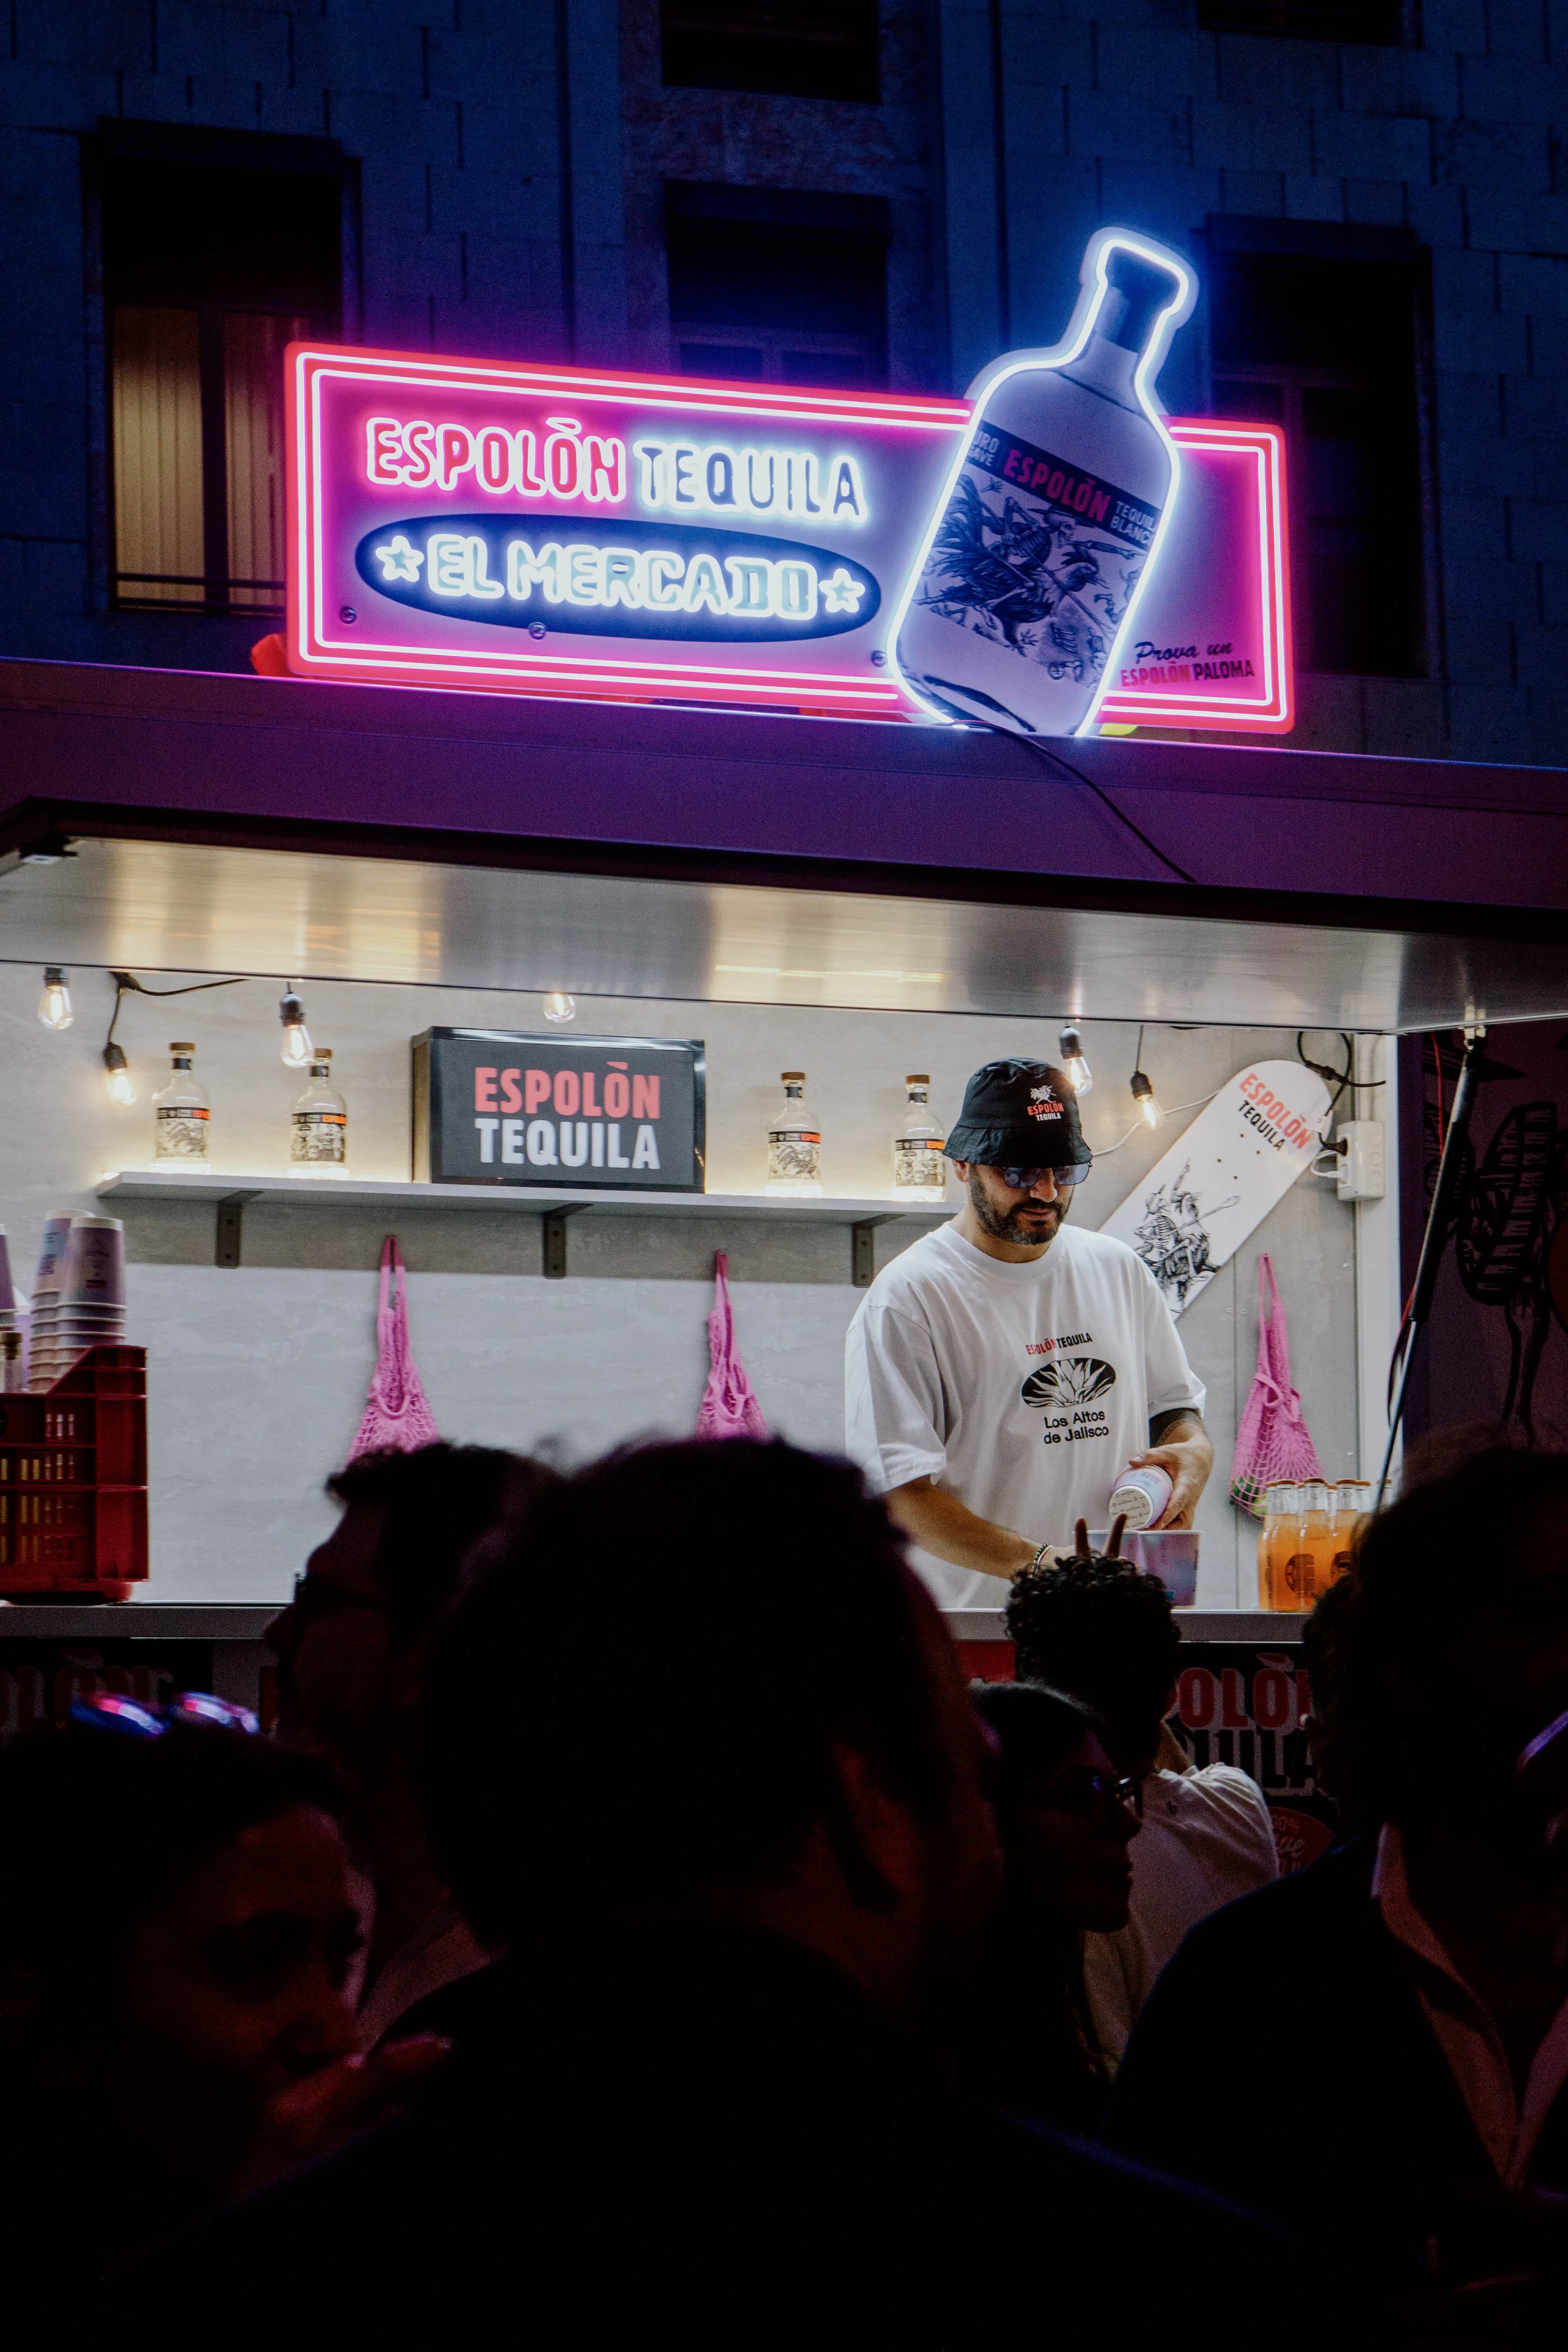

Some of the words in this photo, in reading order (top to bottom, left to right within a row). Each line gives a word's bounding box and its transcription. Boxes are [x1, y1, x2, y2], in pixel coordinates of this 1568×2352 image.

[633, 440, 867, 523] TEQUILA
[427, 534, 505, 599] EL
[507, 540, 817, 621] MERCADO
[1134, 641, 1200, 664] Prova
[1207, 642, 1234, 656] un
[1192, 659, 1255, 681] PALOMA
[1036, 1112, 1062, 1121] TEQUILA
[1238, 1100, 1285, 1152] TEQUILA
[474, 1118, 660, 1169] TEQUILA
[1056, 1332, 1093, 1349] TEQUILA
[1044, 1417, 1069, 1429] Los
[1073, 1411, 1105, 1424] Altos
[1044, 1432, 1061, 1444] de
[1065, 1426, 1109, 1442] Jalisco
